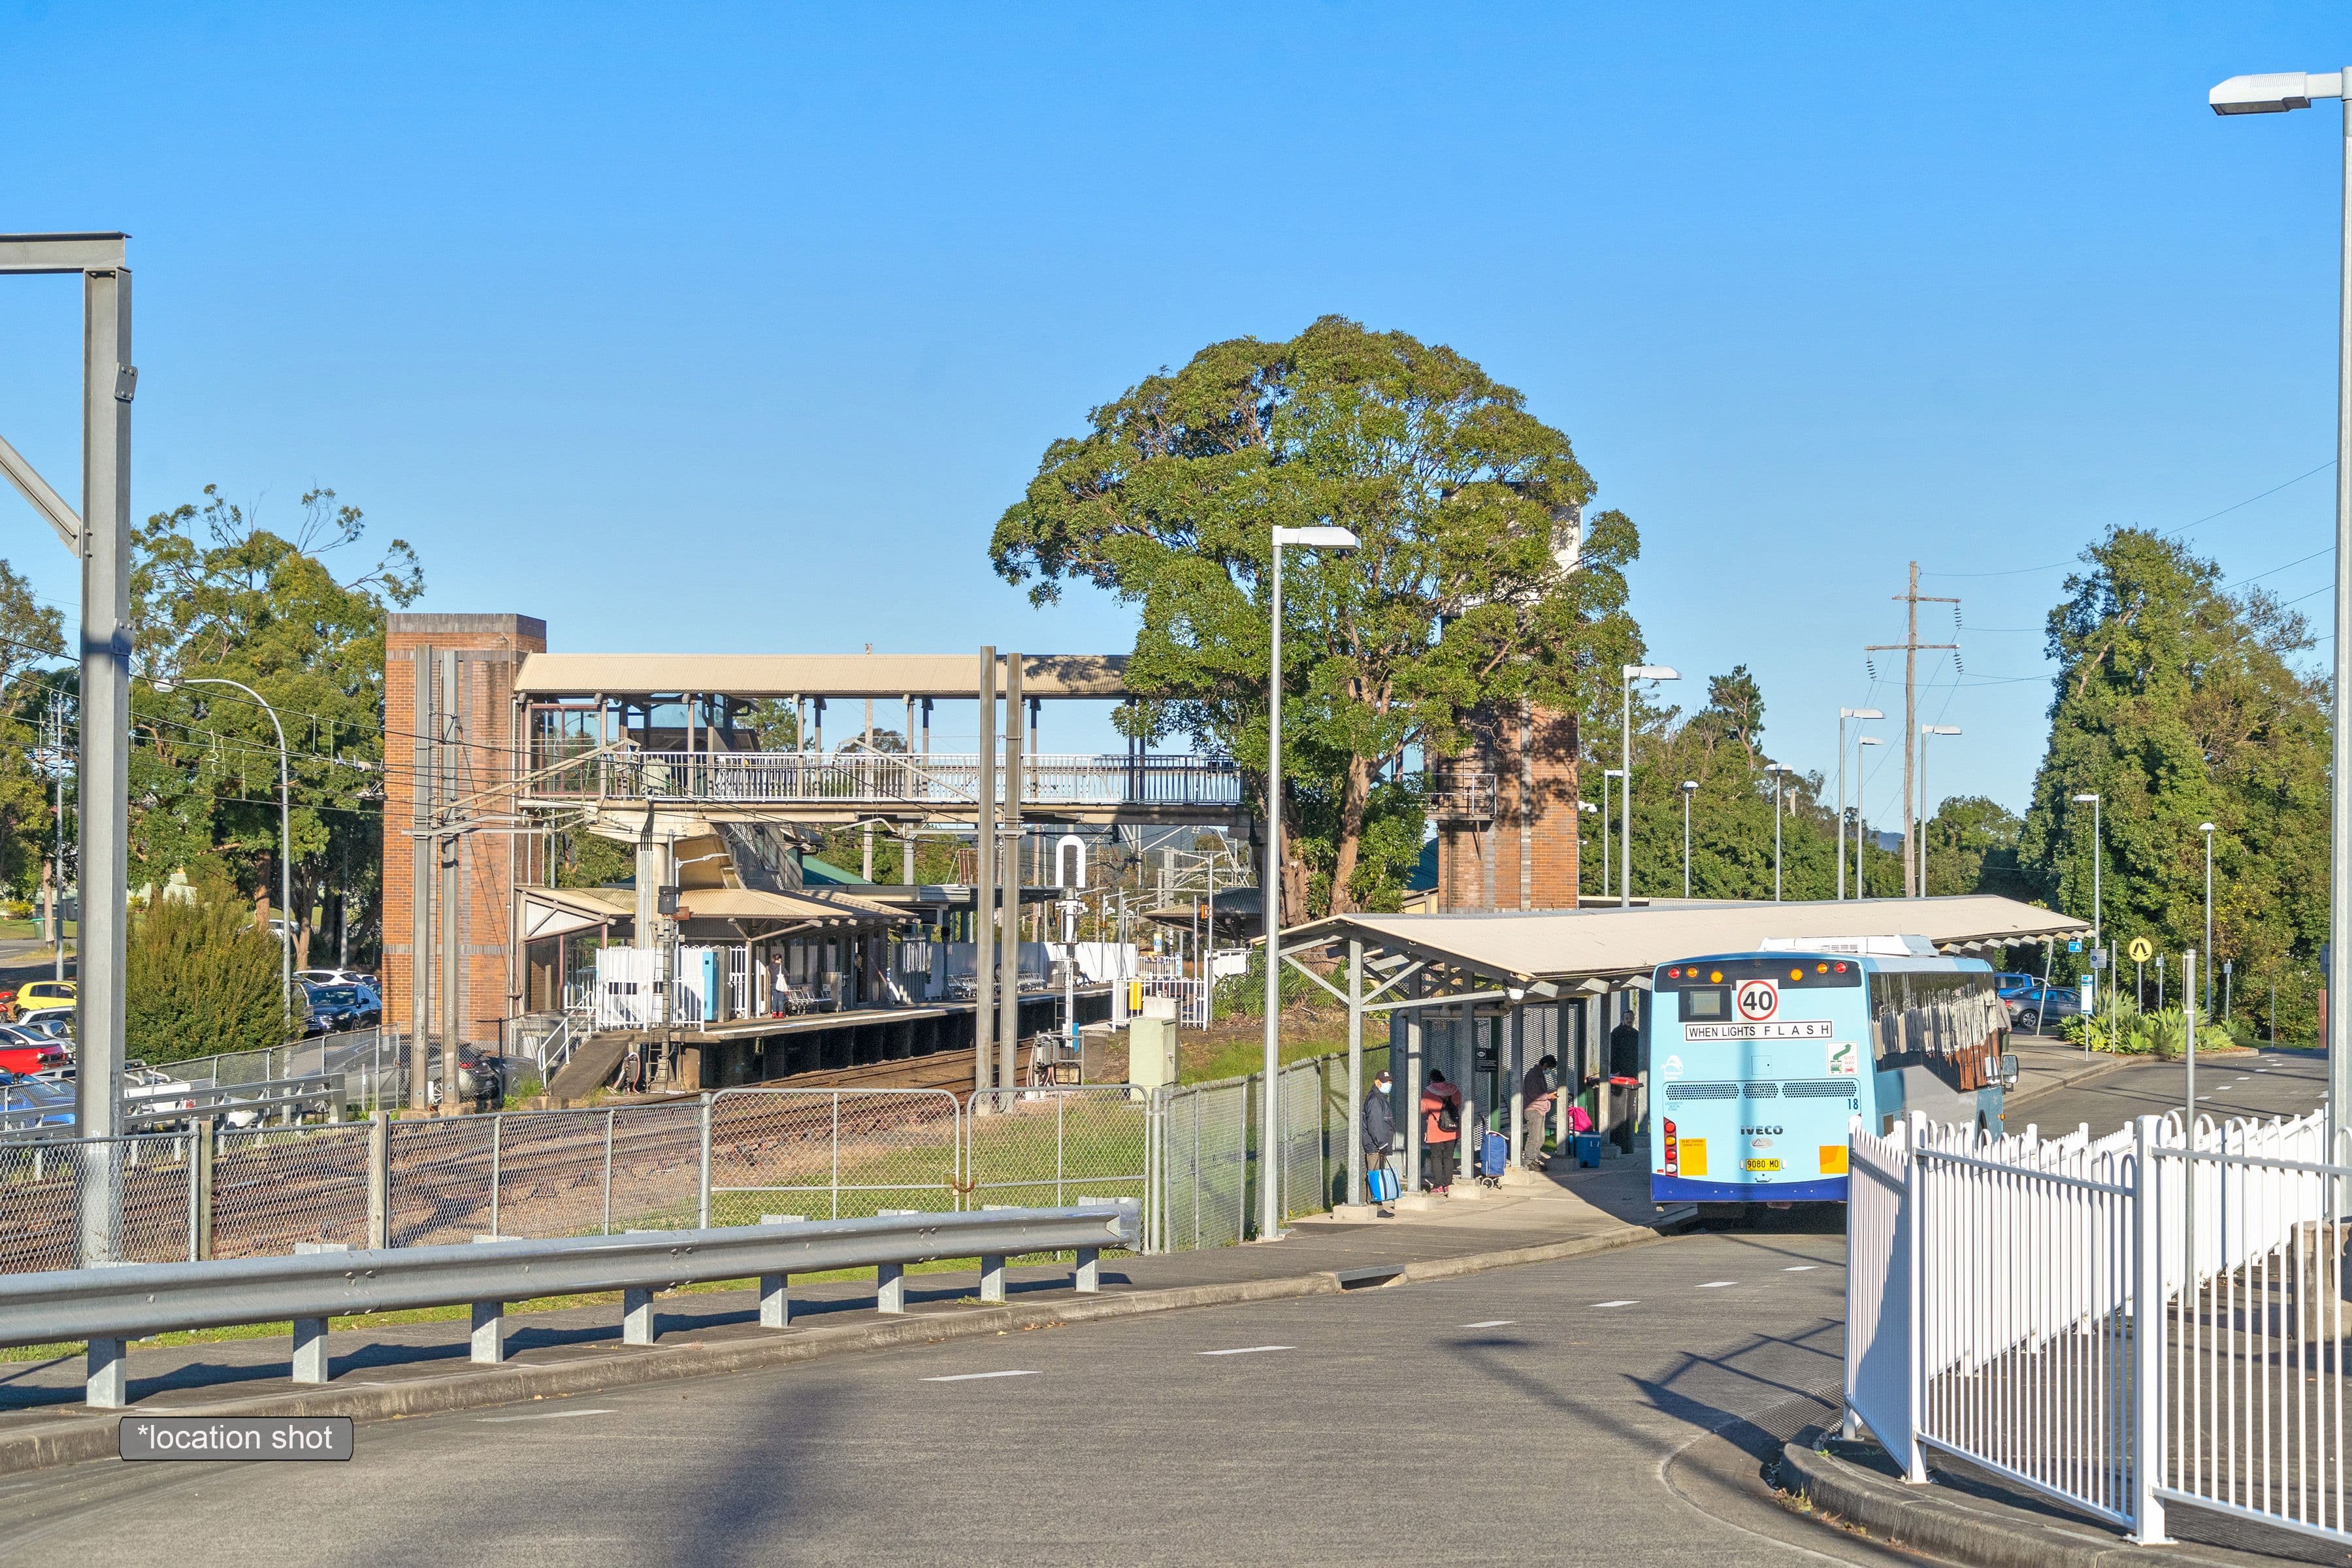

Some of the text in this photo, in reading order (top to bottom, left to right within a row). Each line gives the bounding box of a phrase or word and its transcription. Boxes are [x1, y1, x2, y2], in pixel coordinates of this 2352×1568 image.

[1742, 990, 1772, 1011] 40
[1689, 1027, 1718, 1037] WHEN
[1722, 1026, 1756, 1037] LIGHTS
[1848, 1098, 1858, 1110] 18
[1740, 1125, 1784, 1135] IVECO
[1747, 1160, 1779, 1168] 9080 MO
